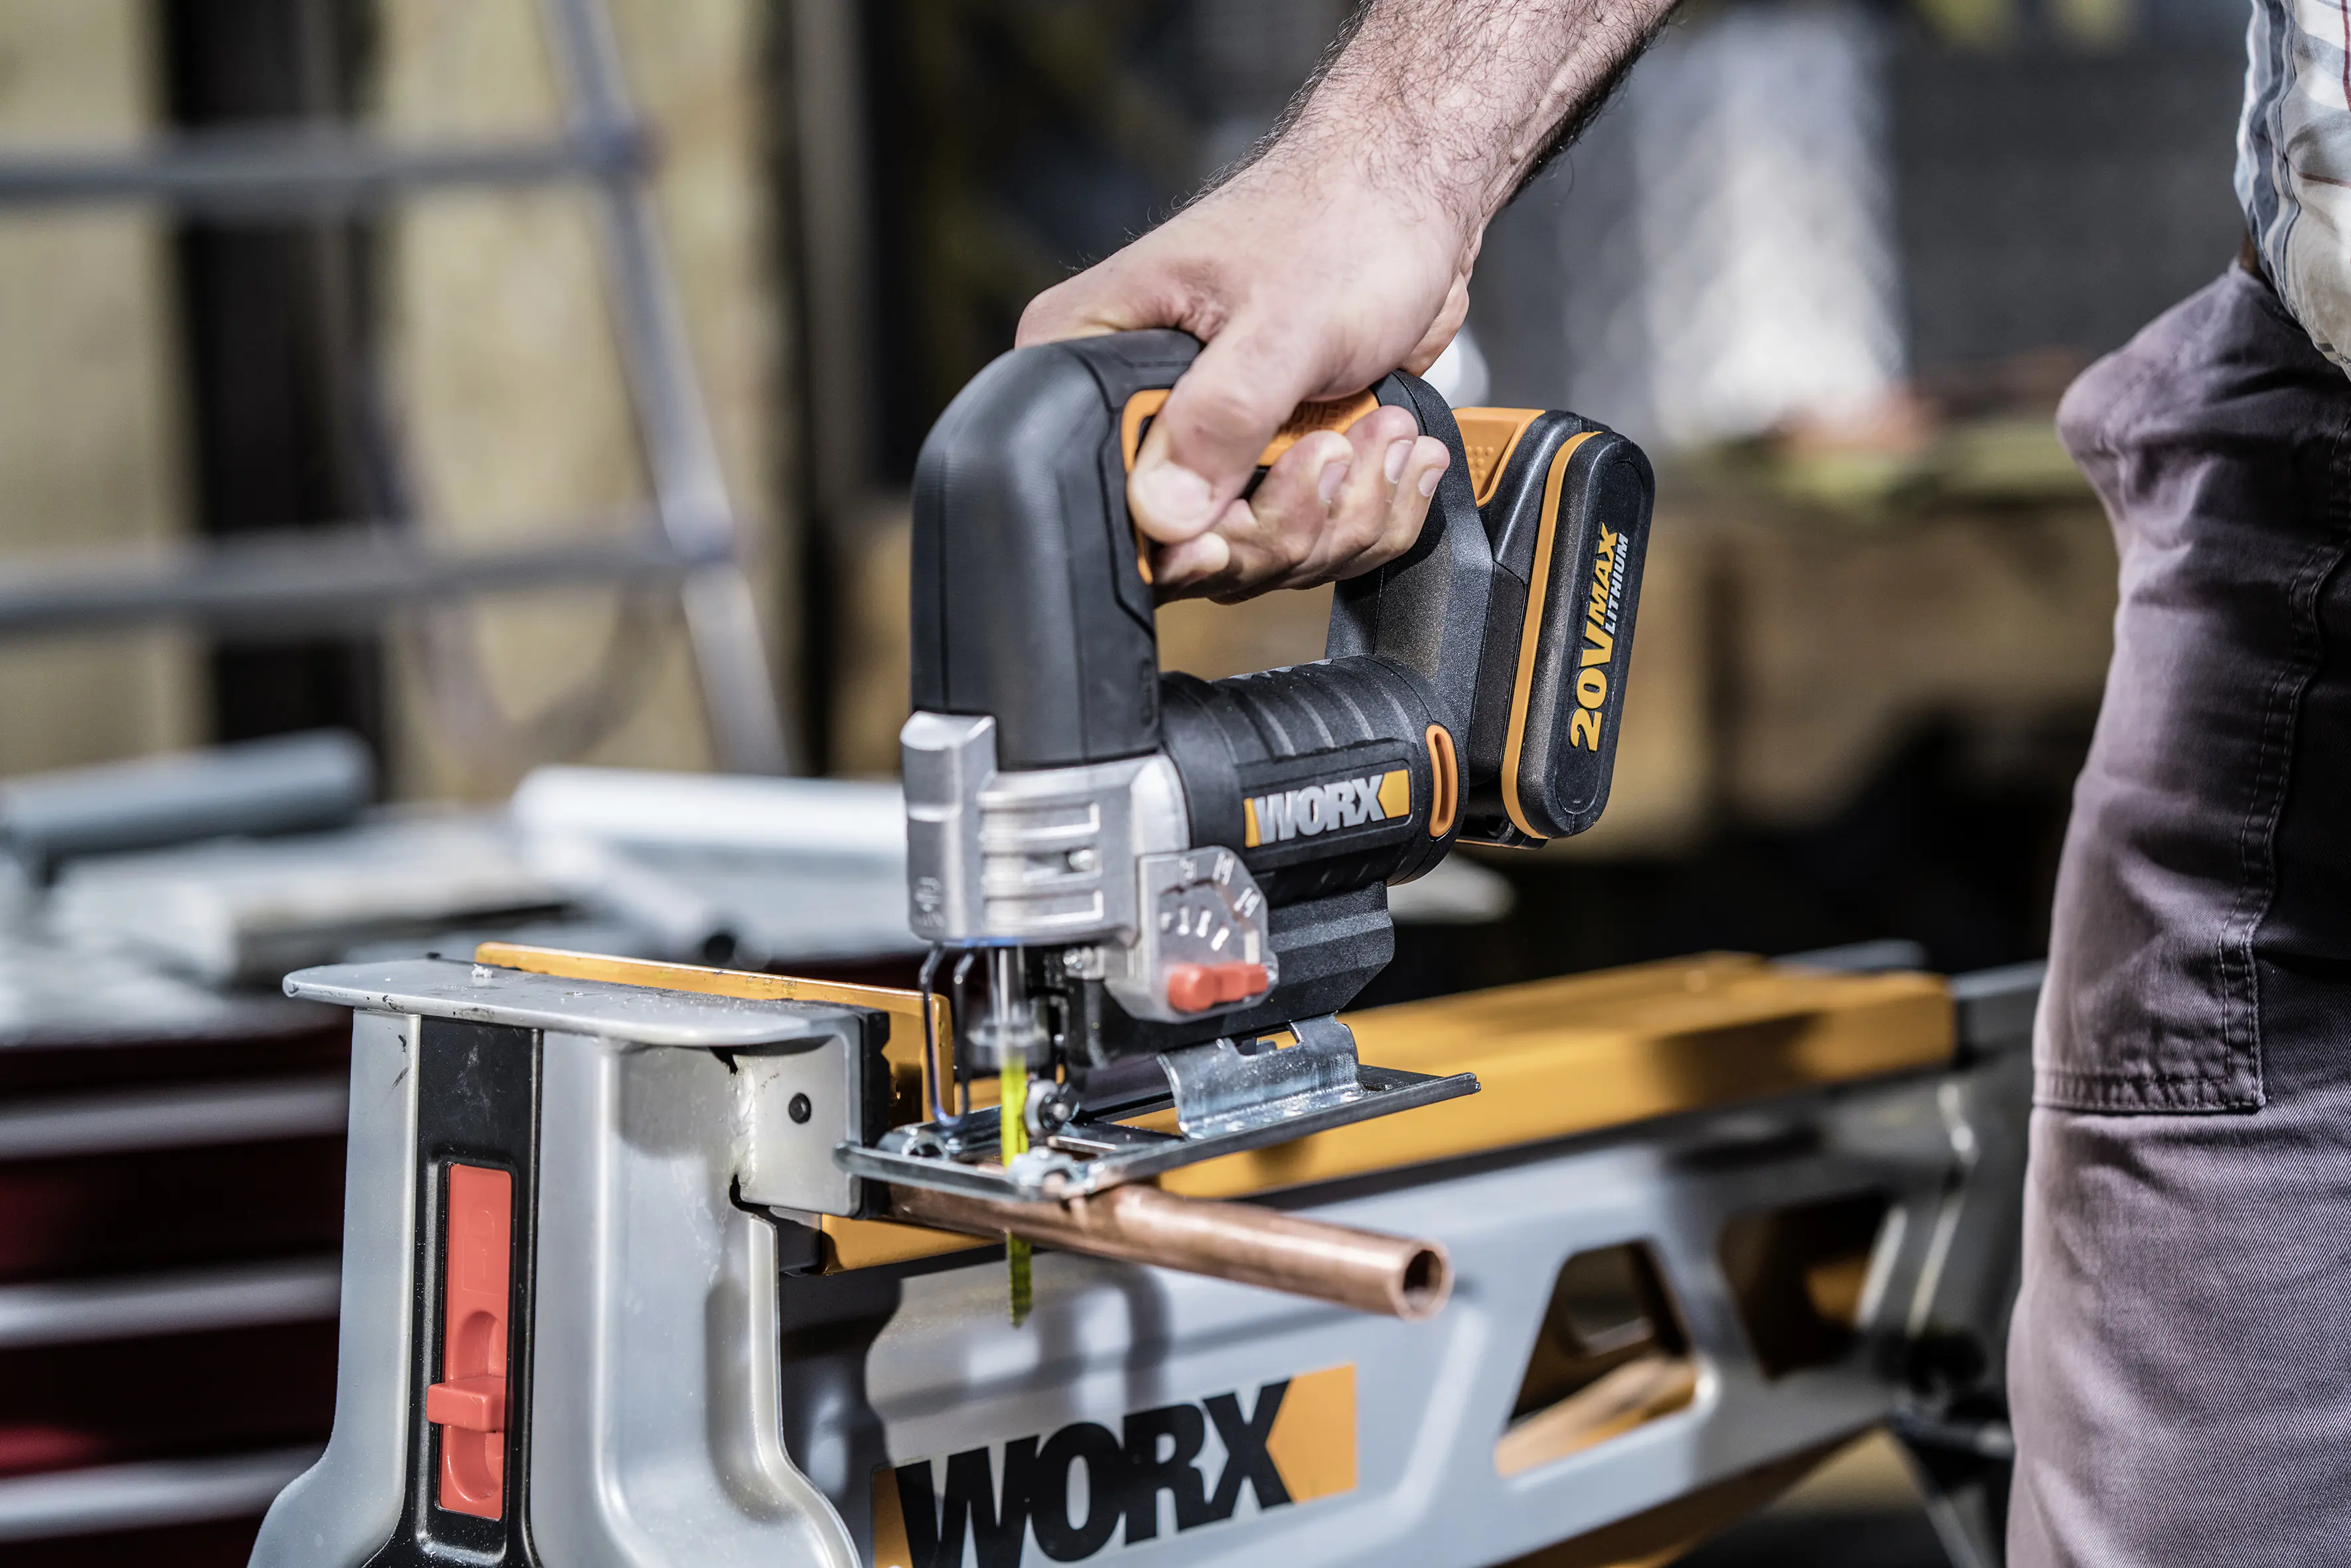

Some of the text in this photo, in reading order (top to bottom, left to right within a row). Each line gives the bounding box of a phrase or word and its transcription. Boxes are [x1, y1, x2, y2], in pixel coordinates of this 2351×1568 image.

[1604, 533, 1629, 635] LITHIUM
[1253, 774, 1386, 845] WORX
[894, 1376, 1295, 1568] WORX
